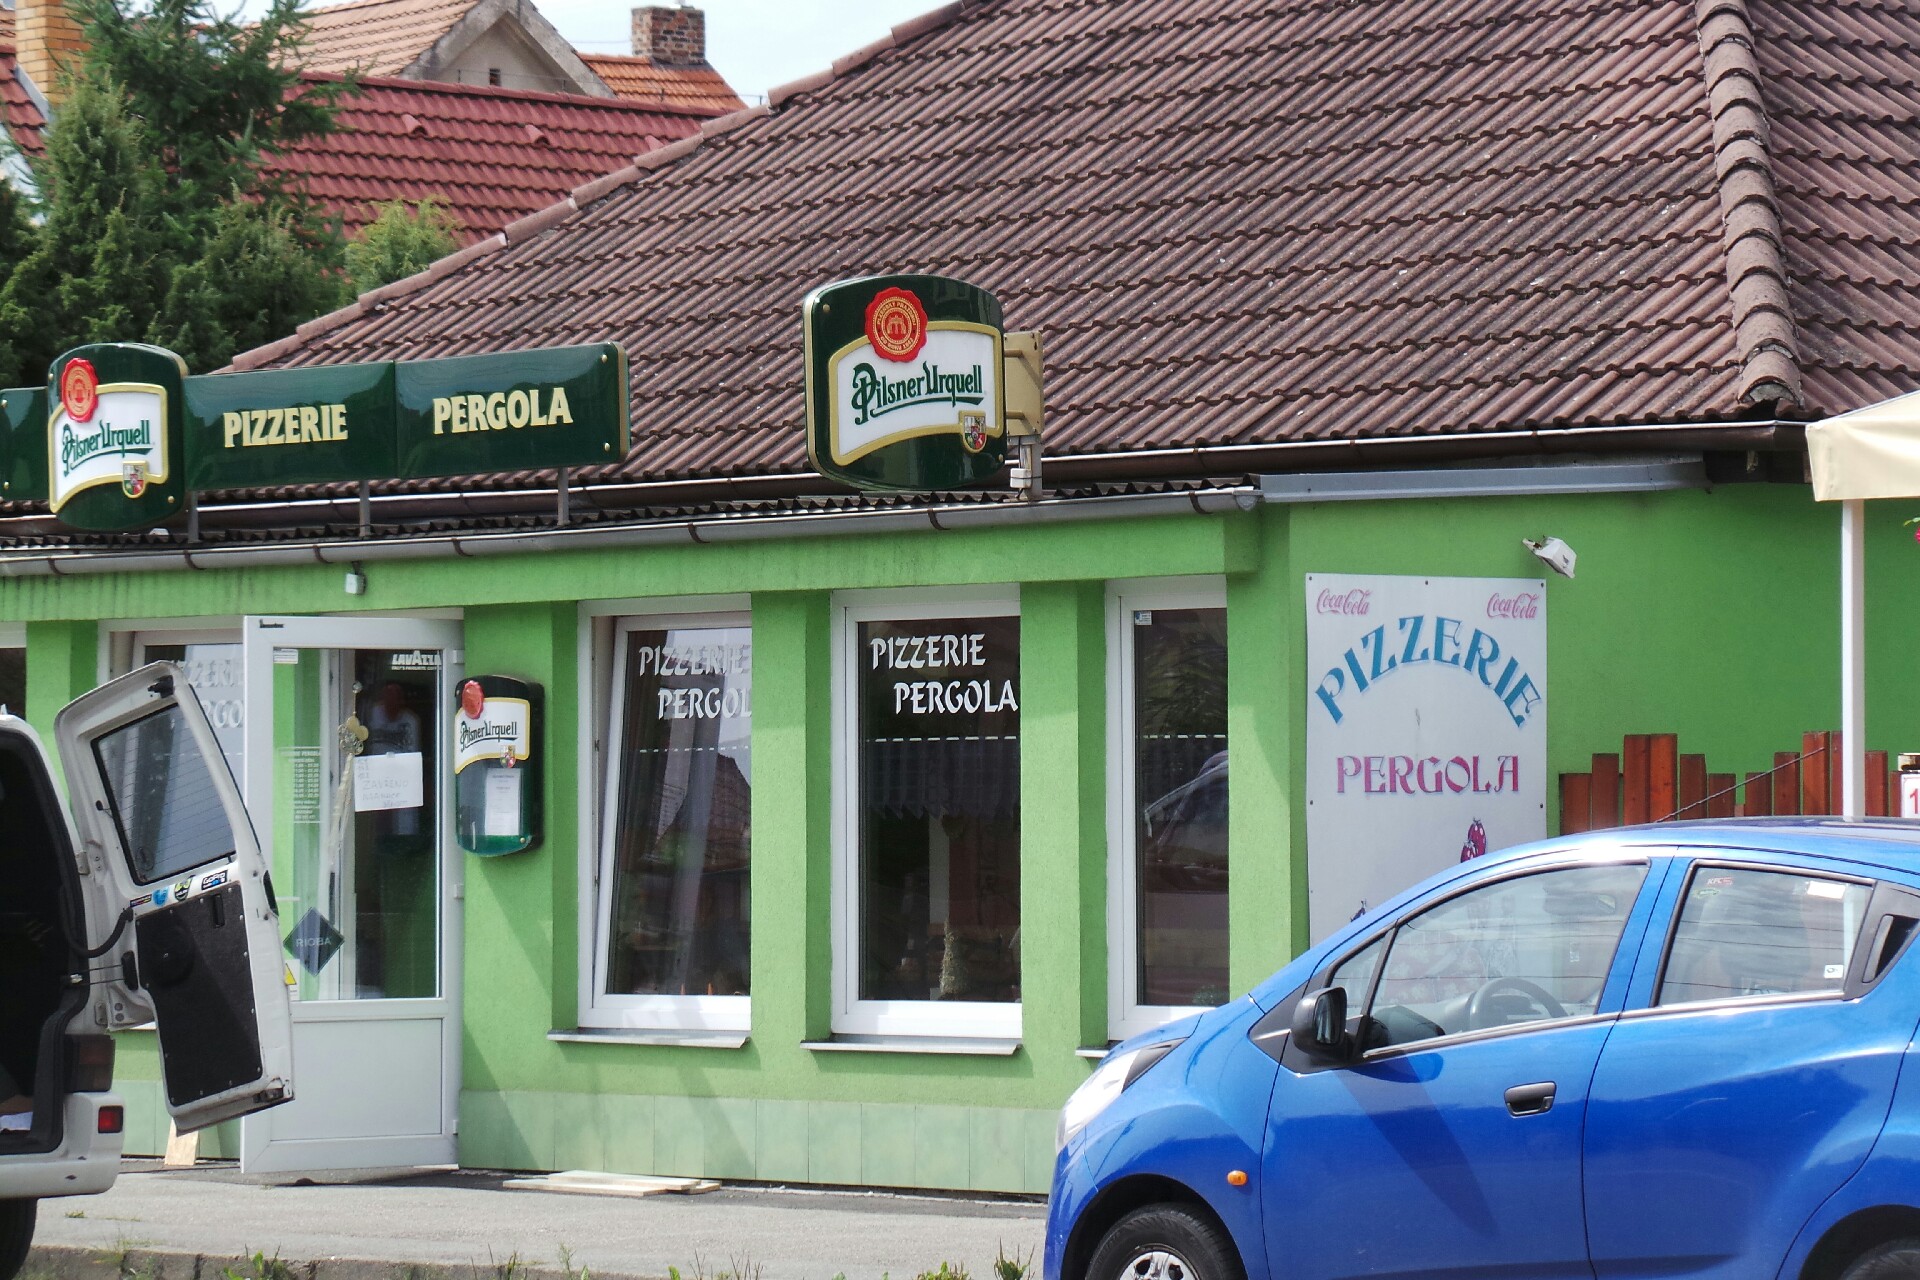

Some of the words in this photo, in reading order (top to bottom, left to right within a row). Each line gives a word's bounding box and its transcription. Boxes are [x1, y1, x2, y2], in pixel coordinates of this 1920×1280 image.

[851, 362, 925, 425] Pilsner
[922, 361, 983, 408] Urquell
[223, 404, 348, 448] PIZZERIE
[433, 387, 573, 435] PERGOLA
[62, 423, 102, 477] Pilsner
[99, 420, 151, 458] Urquell
[392, 650, 442, 666] LAVAZZA
[639, 644, 746, 677] PIZZERIE
[870, 633, 986, 670] PIZZERIE
[1315, 615, 1542, 728] PIZZERIE
[657, 687, 752, 720] PERGOL
[893, 679, 1019, 715] PERGOLA
[460, 721, 487, 753] Pilsner
[484, 720, 518, 742] Urquell
[1336, 755, 1519, 794] PERGOLA
[295, 937, 332, 948] RIOBA
